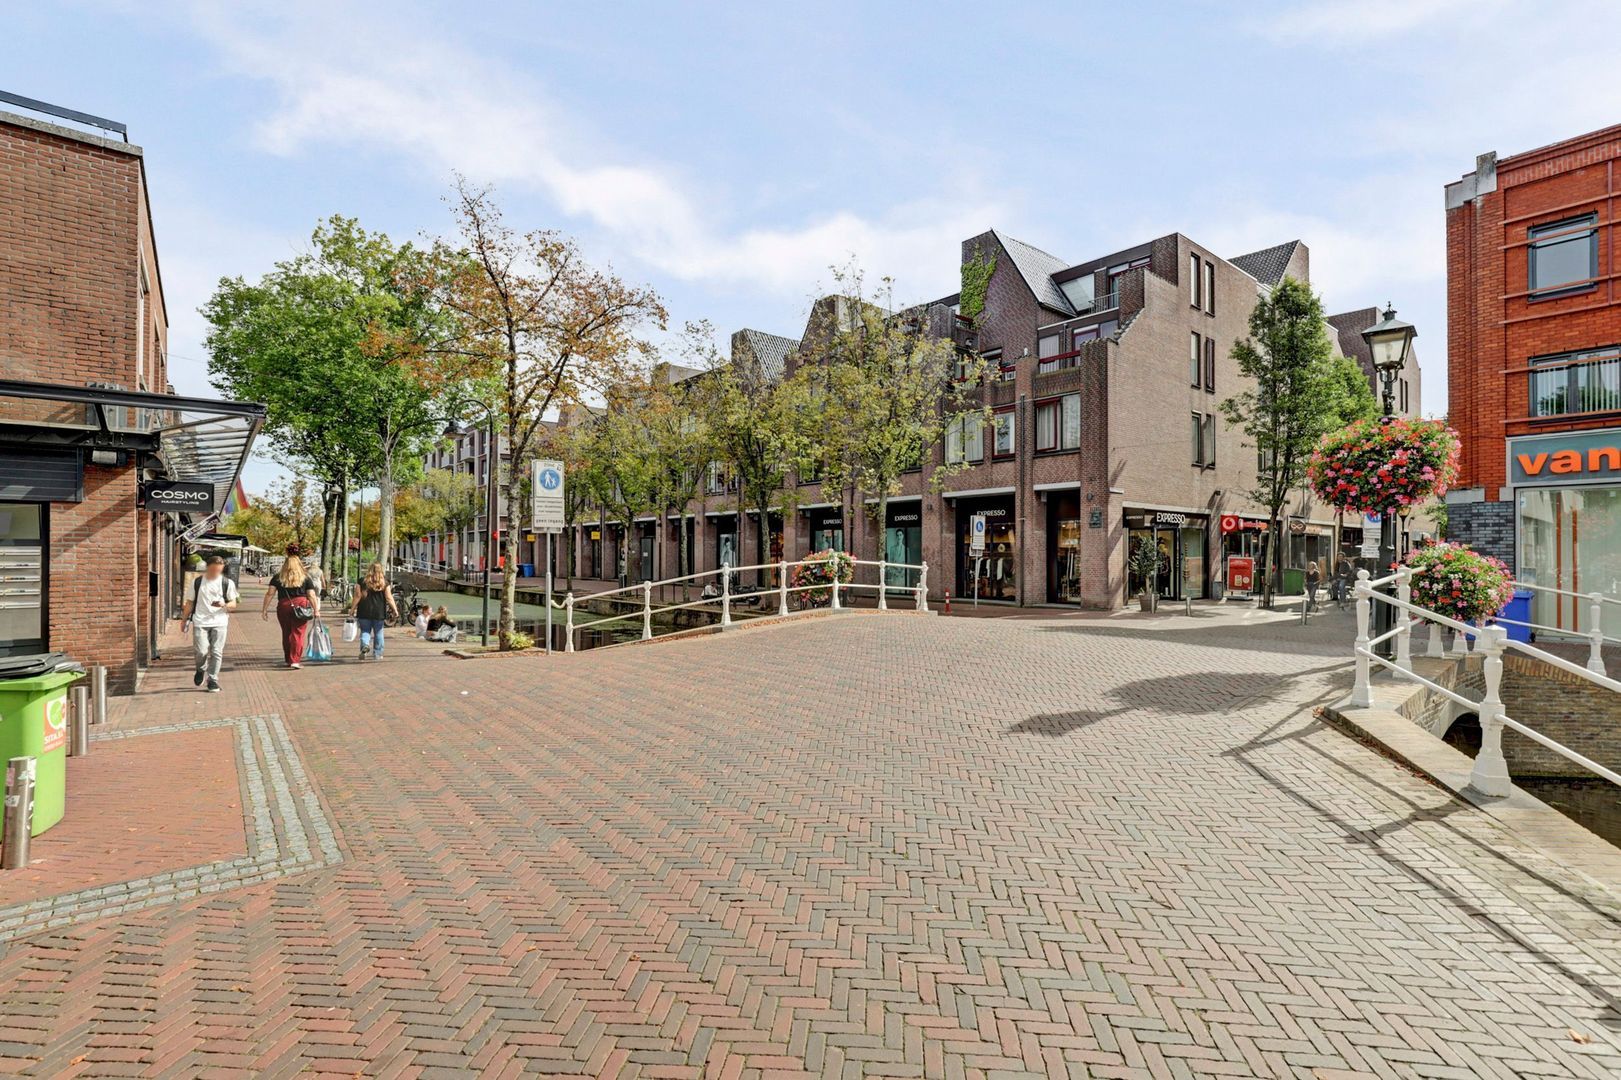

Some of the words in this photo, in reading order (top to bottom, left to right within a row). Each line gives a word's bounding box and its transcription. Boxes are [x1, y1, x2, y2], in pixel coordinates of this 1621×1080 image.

[1517, 446, 1621, 476] van
[151, 490, 209, 500] COSMO
[976, 509, 1006, 517] EXPRESSO
[1156, 512, 1186, 524] EXPRESSO
